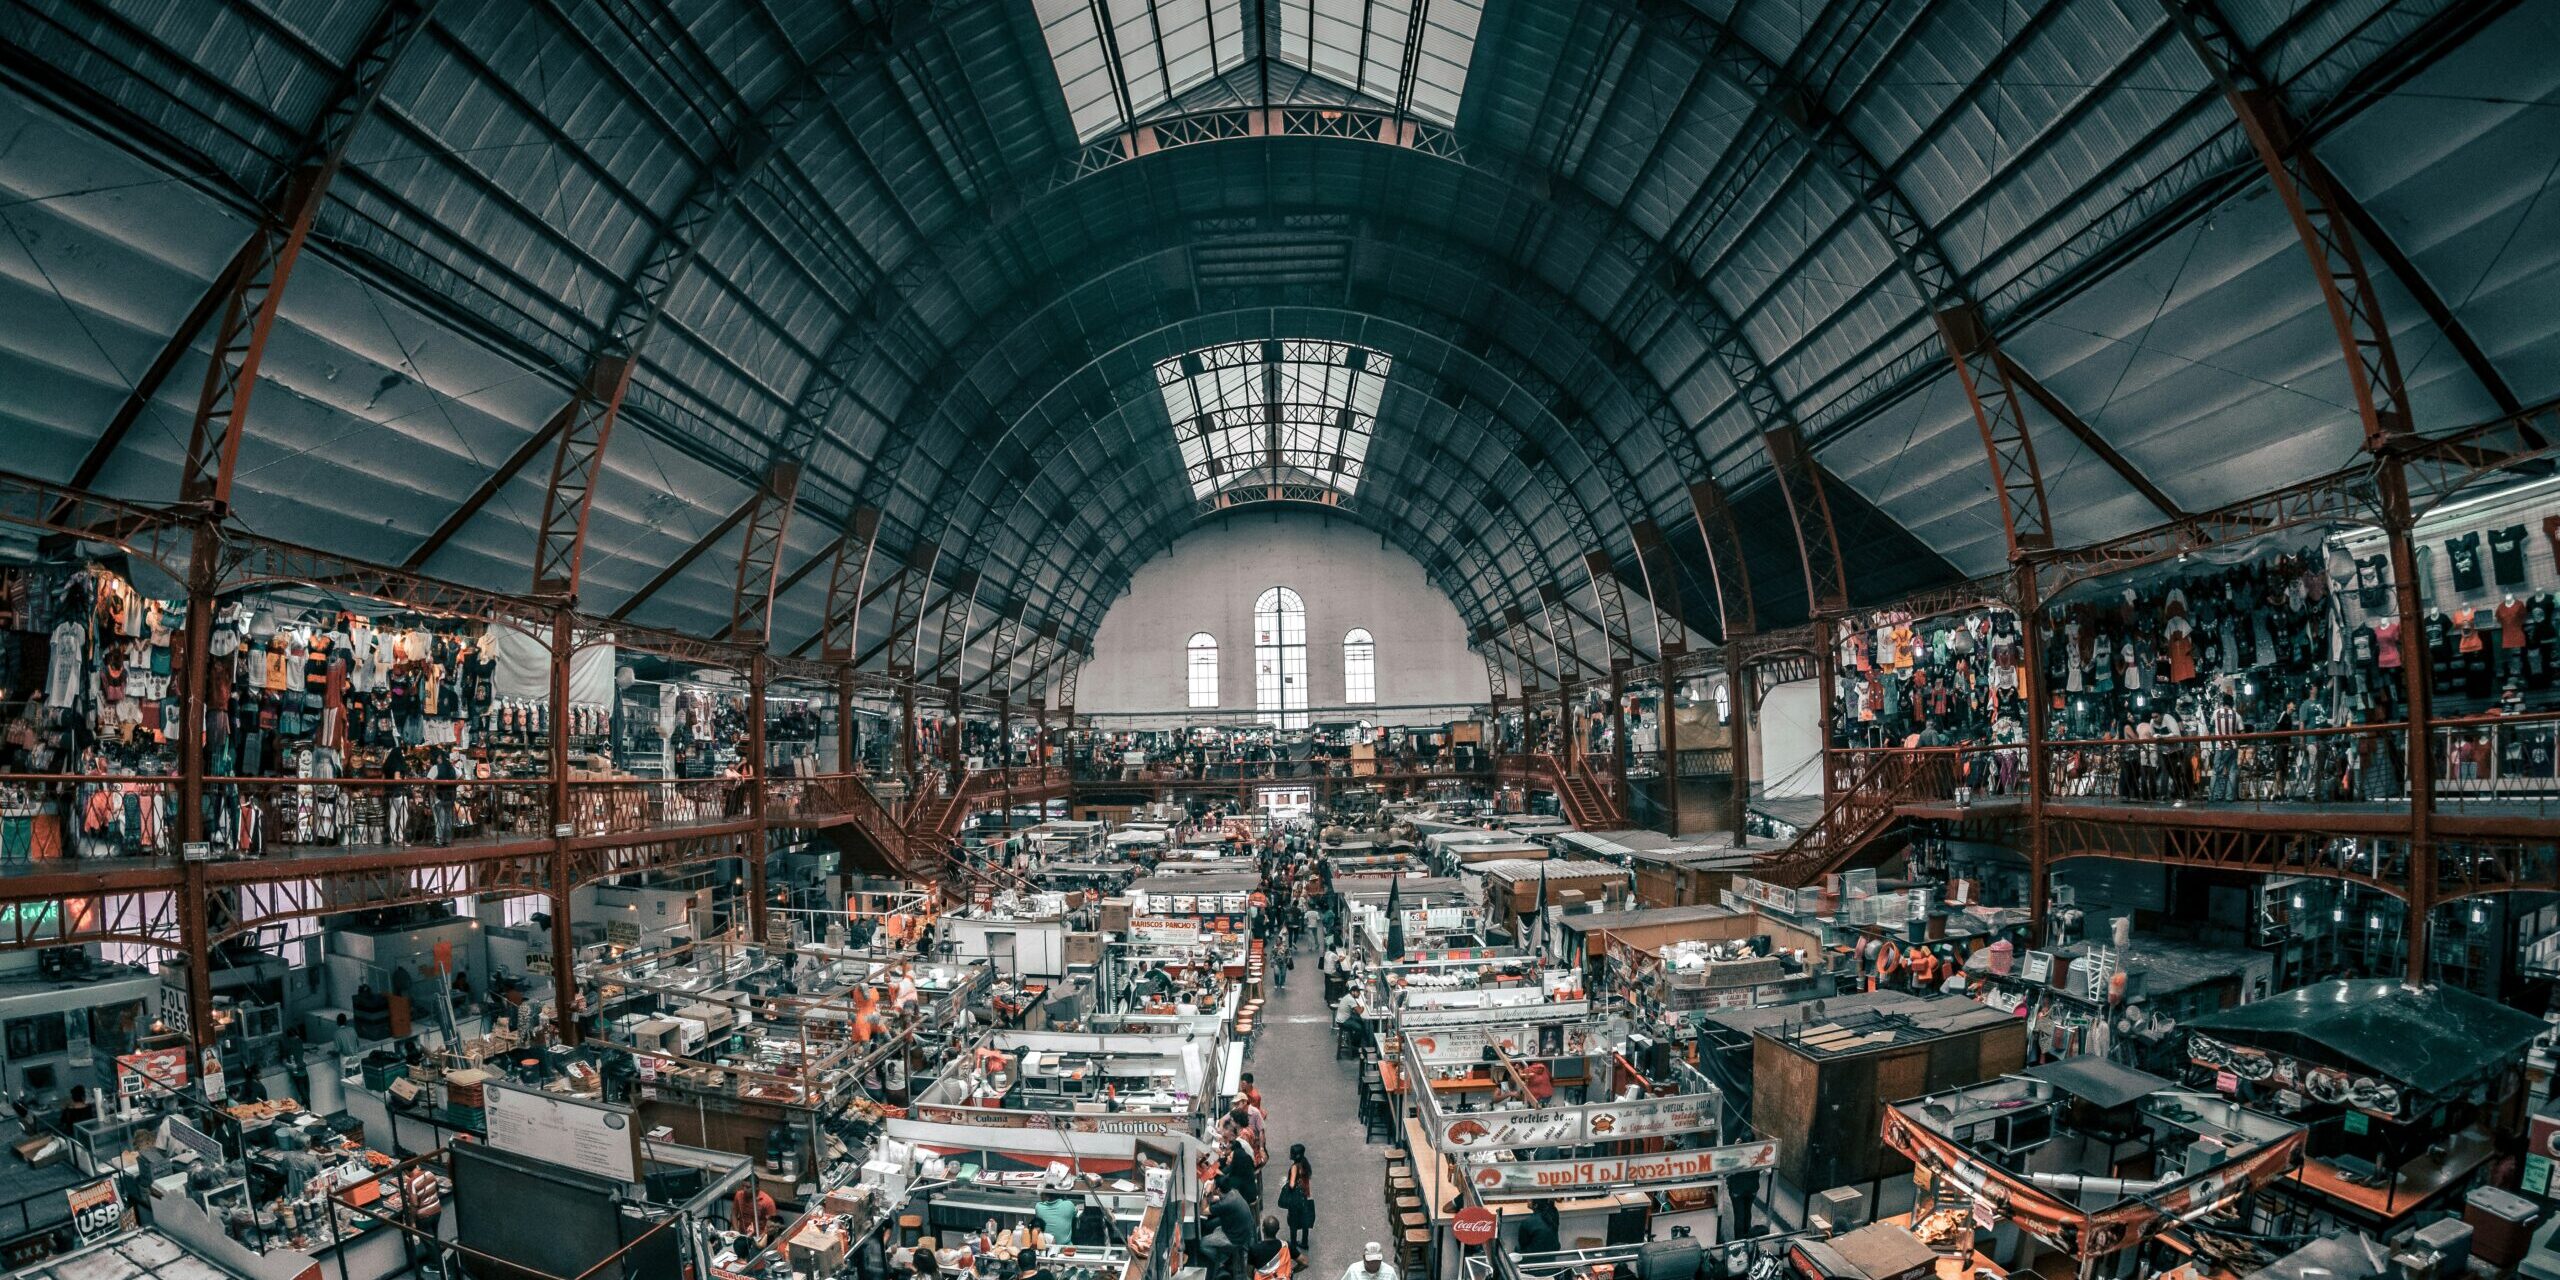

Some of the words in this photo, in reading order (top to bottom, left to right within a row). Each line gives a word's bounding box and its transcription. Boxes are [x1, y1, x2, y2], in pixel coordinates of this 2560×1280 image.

[1131, 920, 1163, 928] MARISCOS
[1165, 921, 1196, 929] PANCHO'S
[1098, 1119, 1167, 1134] Antojitos
[1453, 1219, 1494, 1233] Coca-Cola
